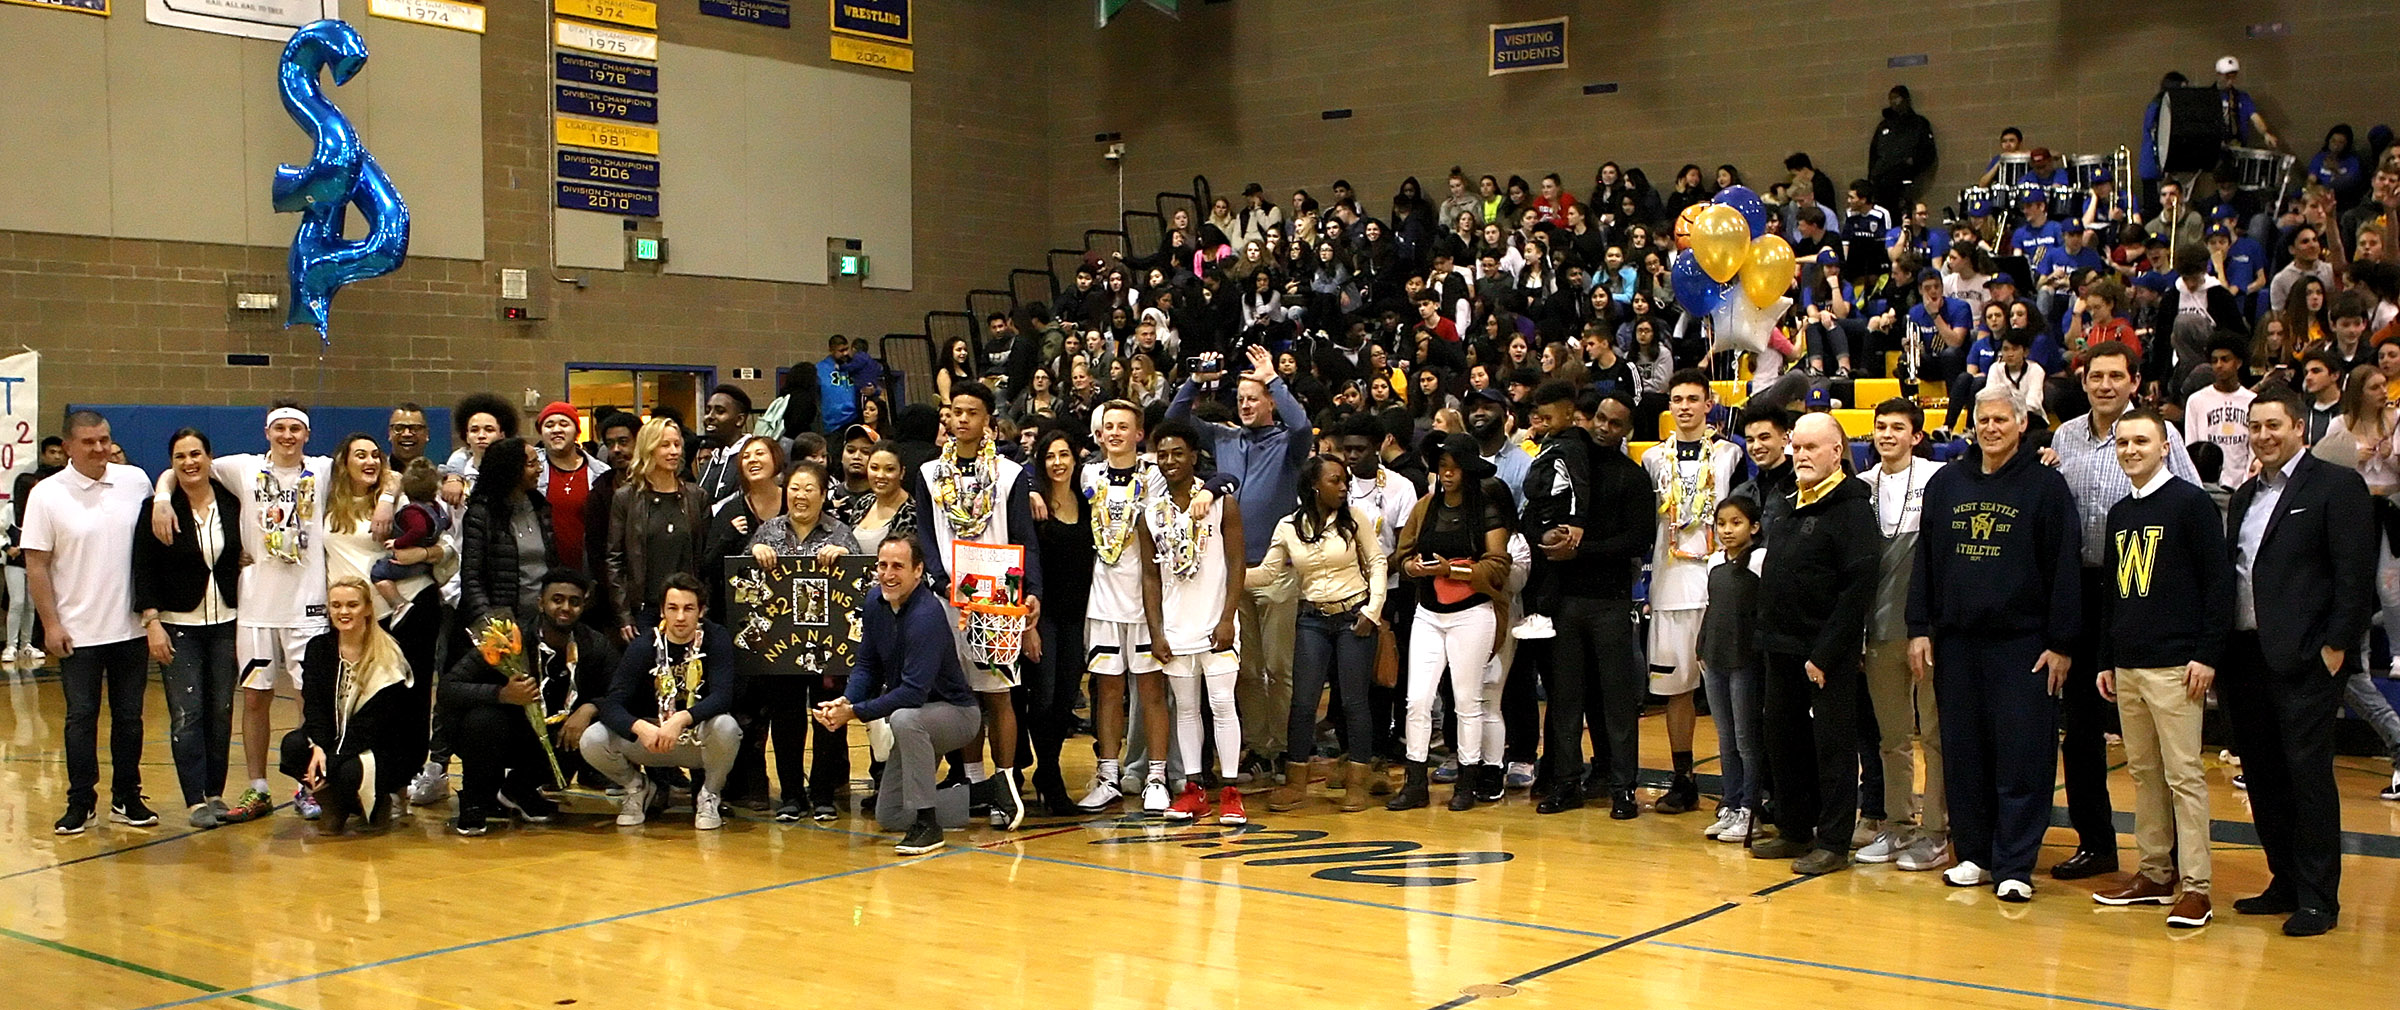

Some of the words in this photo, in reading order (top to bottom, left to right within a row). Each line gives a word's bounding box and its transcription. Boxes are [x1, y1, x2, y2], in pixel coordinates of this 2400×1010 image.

[407, 6, 449, 22] 1974
[588, 4, 625, 19] 1974
[731, 6, 761, 19] 2013
[842, 4, 902, 27] WRESTLING
[567, 25, 594, 36] STATE
[589, 37, 627, 53] 1975
[1503, 31, 1555, 47] VISITING
[855, 51, 888, 65] 2004
[1497, 46, 1562, 63] STUDENTS
[562, 56, 601, 69] DIVISION
[602, 63, 652, 77] CHAMPIONS
[590, 69, 627, 85] 1978
[562, 89, 601, 101] DIVISION
[602, 95, 653, 108] CHAMPIONS
[589, 101, 628, 116] 1979
[591, 133, 627, 147] 1981
[563, 154, 602, 166] DIVISION
[603, 160, 655, 172] CHAMPIONS
[589, 165, 631, 180] 2006
[562, 185, 602, 197] DIVISION
[603, 190, 654, 202] CHAMPIONS
[588, 195, 630, 210] 2010
[2206, 407, 2224, 428] WEST
[2225, 407, 2250, 427] SEATTL
[16, 421, 34, 444] 2
[1952, 502, 1979, 515] WEST
[1980, 502, 2020, 519] SEATTLE
[1995, 524, 2012, 533] 1917
[1955, 542, 2002, 557] ATHLETIC
[771, 559, 846, 581] ELIJAH
[2115, 525, 2164, 599] W
[765, 597, 793, 617] #2
[831, 589, 854, 608] WS
